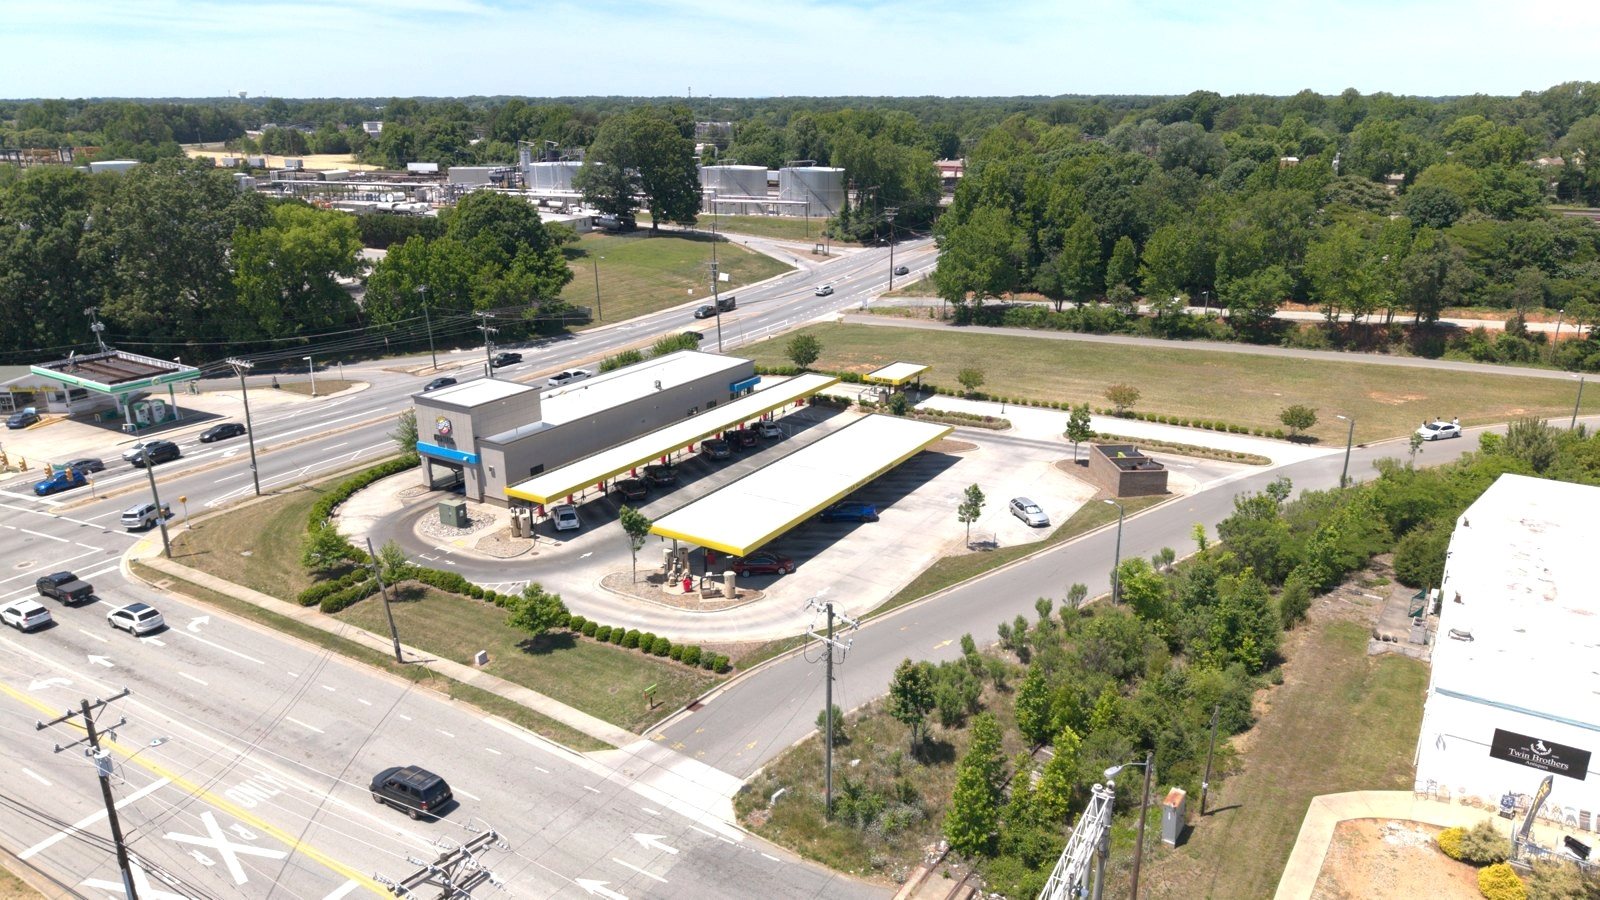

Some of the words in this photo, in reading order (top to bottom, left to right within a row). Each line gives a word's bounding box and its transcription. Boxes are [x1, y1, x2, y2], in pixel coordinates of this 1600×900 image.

[1508, 748, 1530, 760] Twin
[1532, 754, 1569, 770] Brothers
[1525, 760, 1549, 770] Antiques
[224, 771, 288, 808] ONLY
